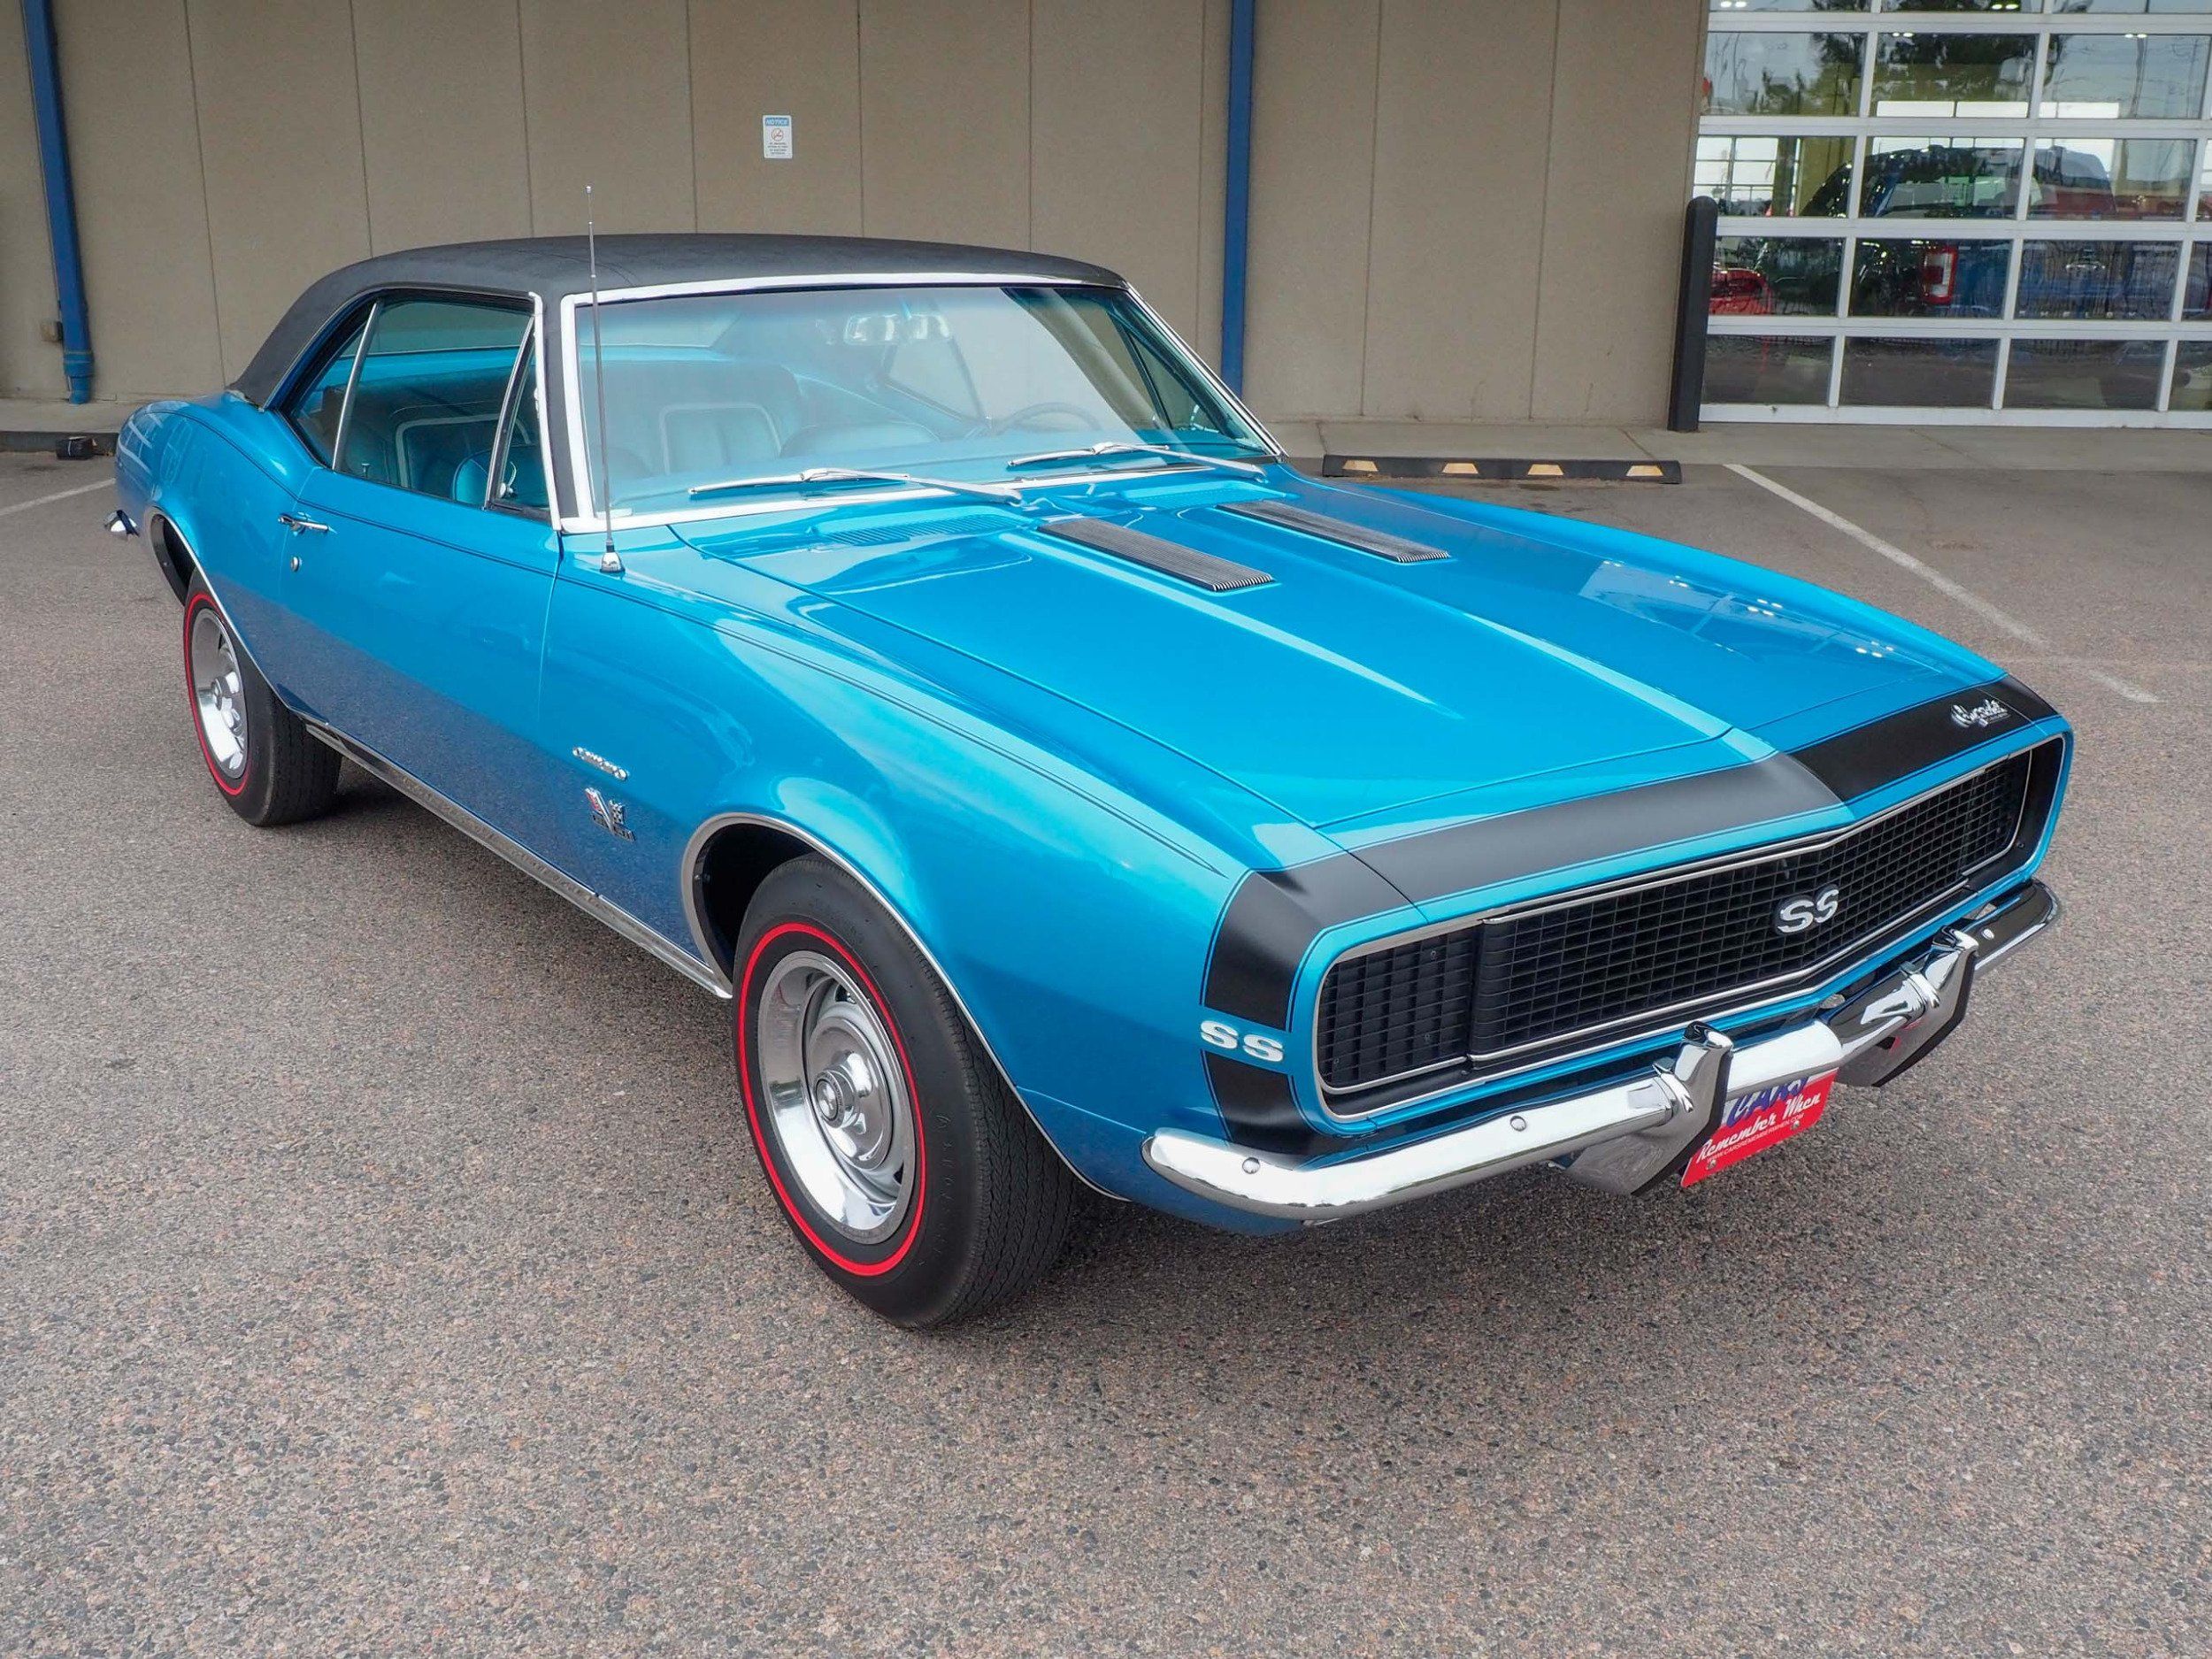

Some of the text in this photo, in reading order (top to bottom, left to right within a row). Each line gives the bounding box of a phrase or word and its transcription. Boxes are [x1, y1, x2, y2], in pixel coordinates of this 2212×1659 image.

[1778, 888, 1839, 933] SS
[1200, 1020, 1283, 1062] SS
[1696, 1093, 1822, 1164] Remember When
